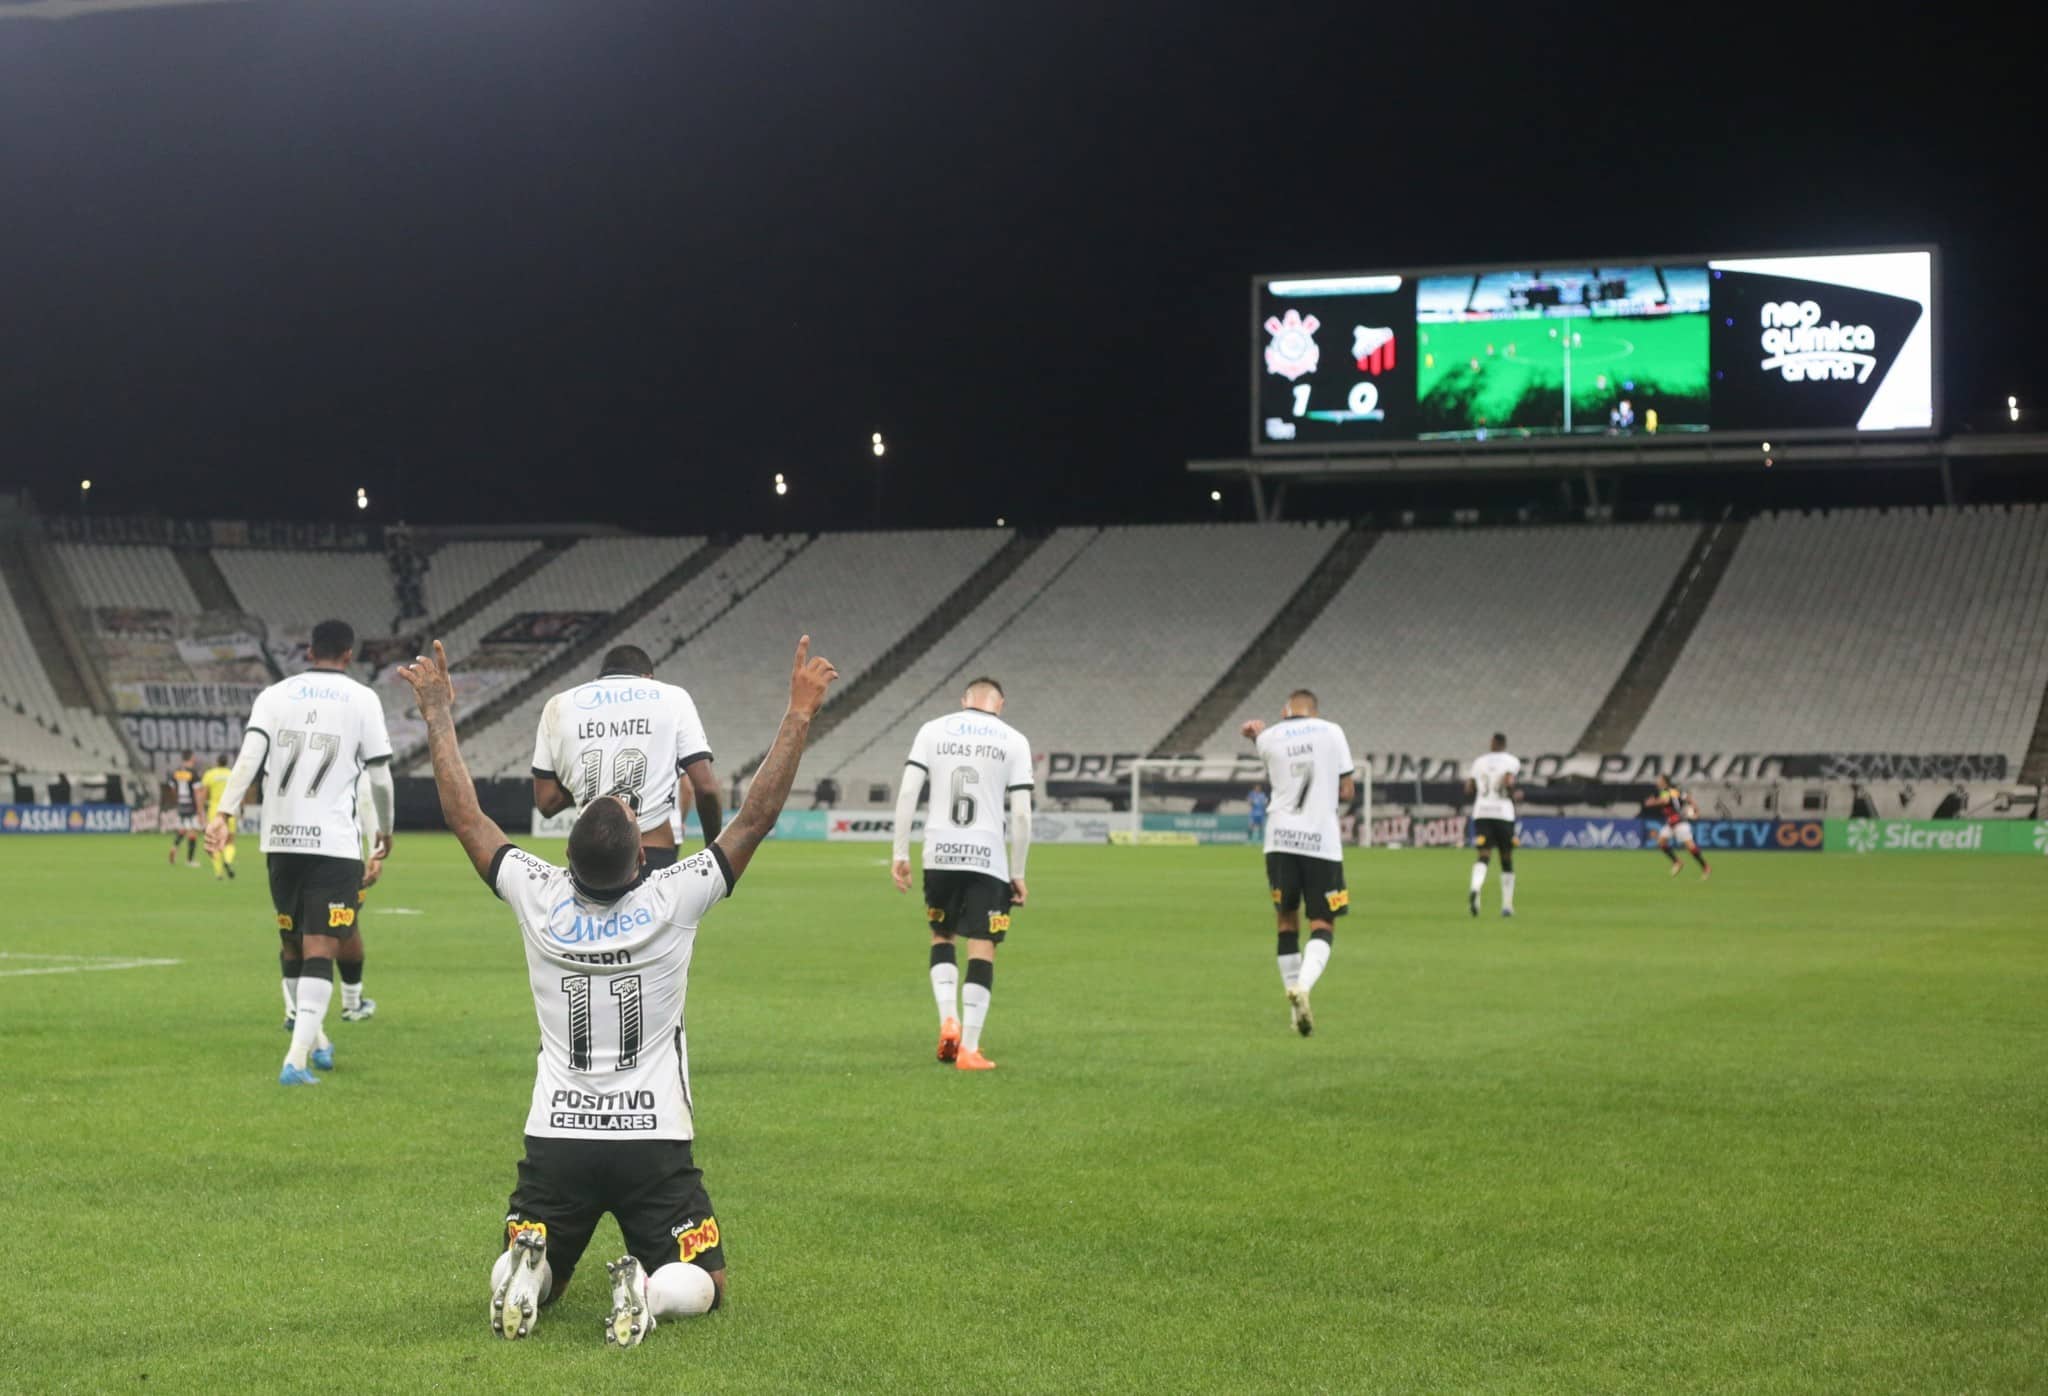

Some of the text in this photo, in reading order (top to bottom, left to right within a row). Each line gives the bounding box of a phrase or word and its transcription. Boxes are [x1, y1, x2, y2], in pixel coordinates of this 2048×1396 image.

[1292, 382, 1378, 417] 1 0
[574, 684, 660, 710] Midea
[578, 717, 652, 741] LÉO NATEL
[936, 741, 1007, 762] LUCAS PITON
[1288, 743, 1313, 758] LUAN
[277, 729, 341, 799] 77
[949, 765, 979, 829] 6
[1290, 760, 1314, 816] 7
[270, 824, 322, 838] POSITIVO
[1777, 823, 1824, 848] GO
[1884, 823, 1983, 849] Sicredi
[935, 842, 991, 858] POSITIVO
[549, 897, 652, 944] Midea
[562, 975, 642, 1072] 11
[551, 1090, 655, 1111] POSITIVO
[552, 1113, 655, 1130] CELULARES
